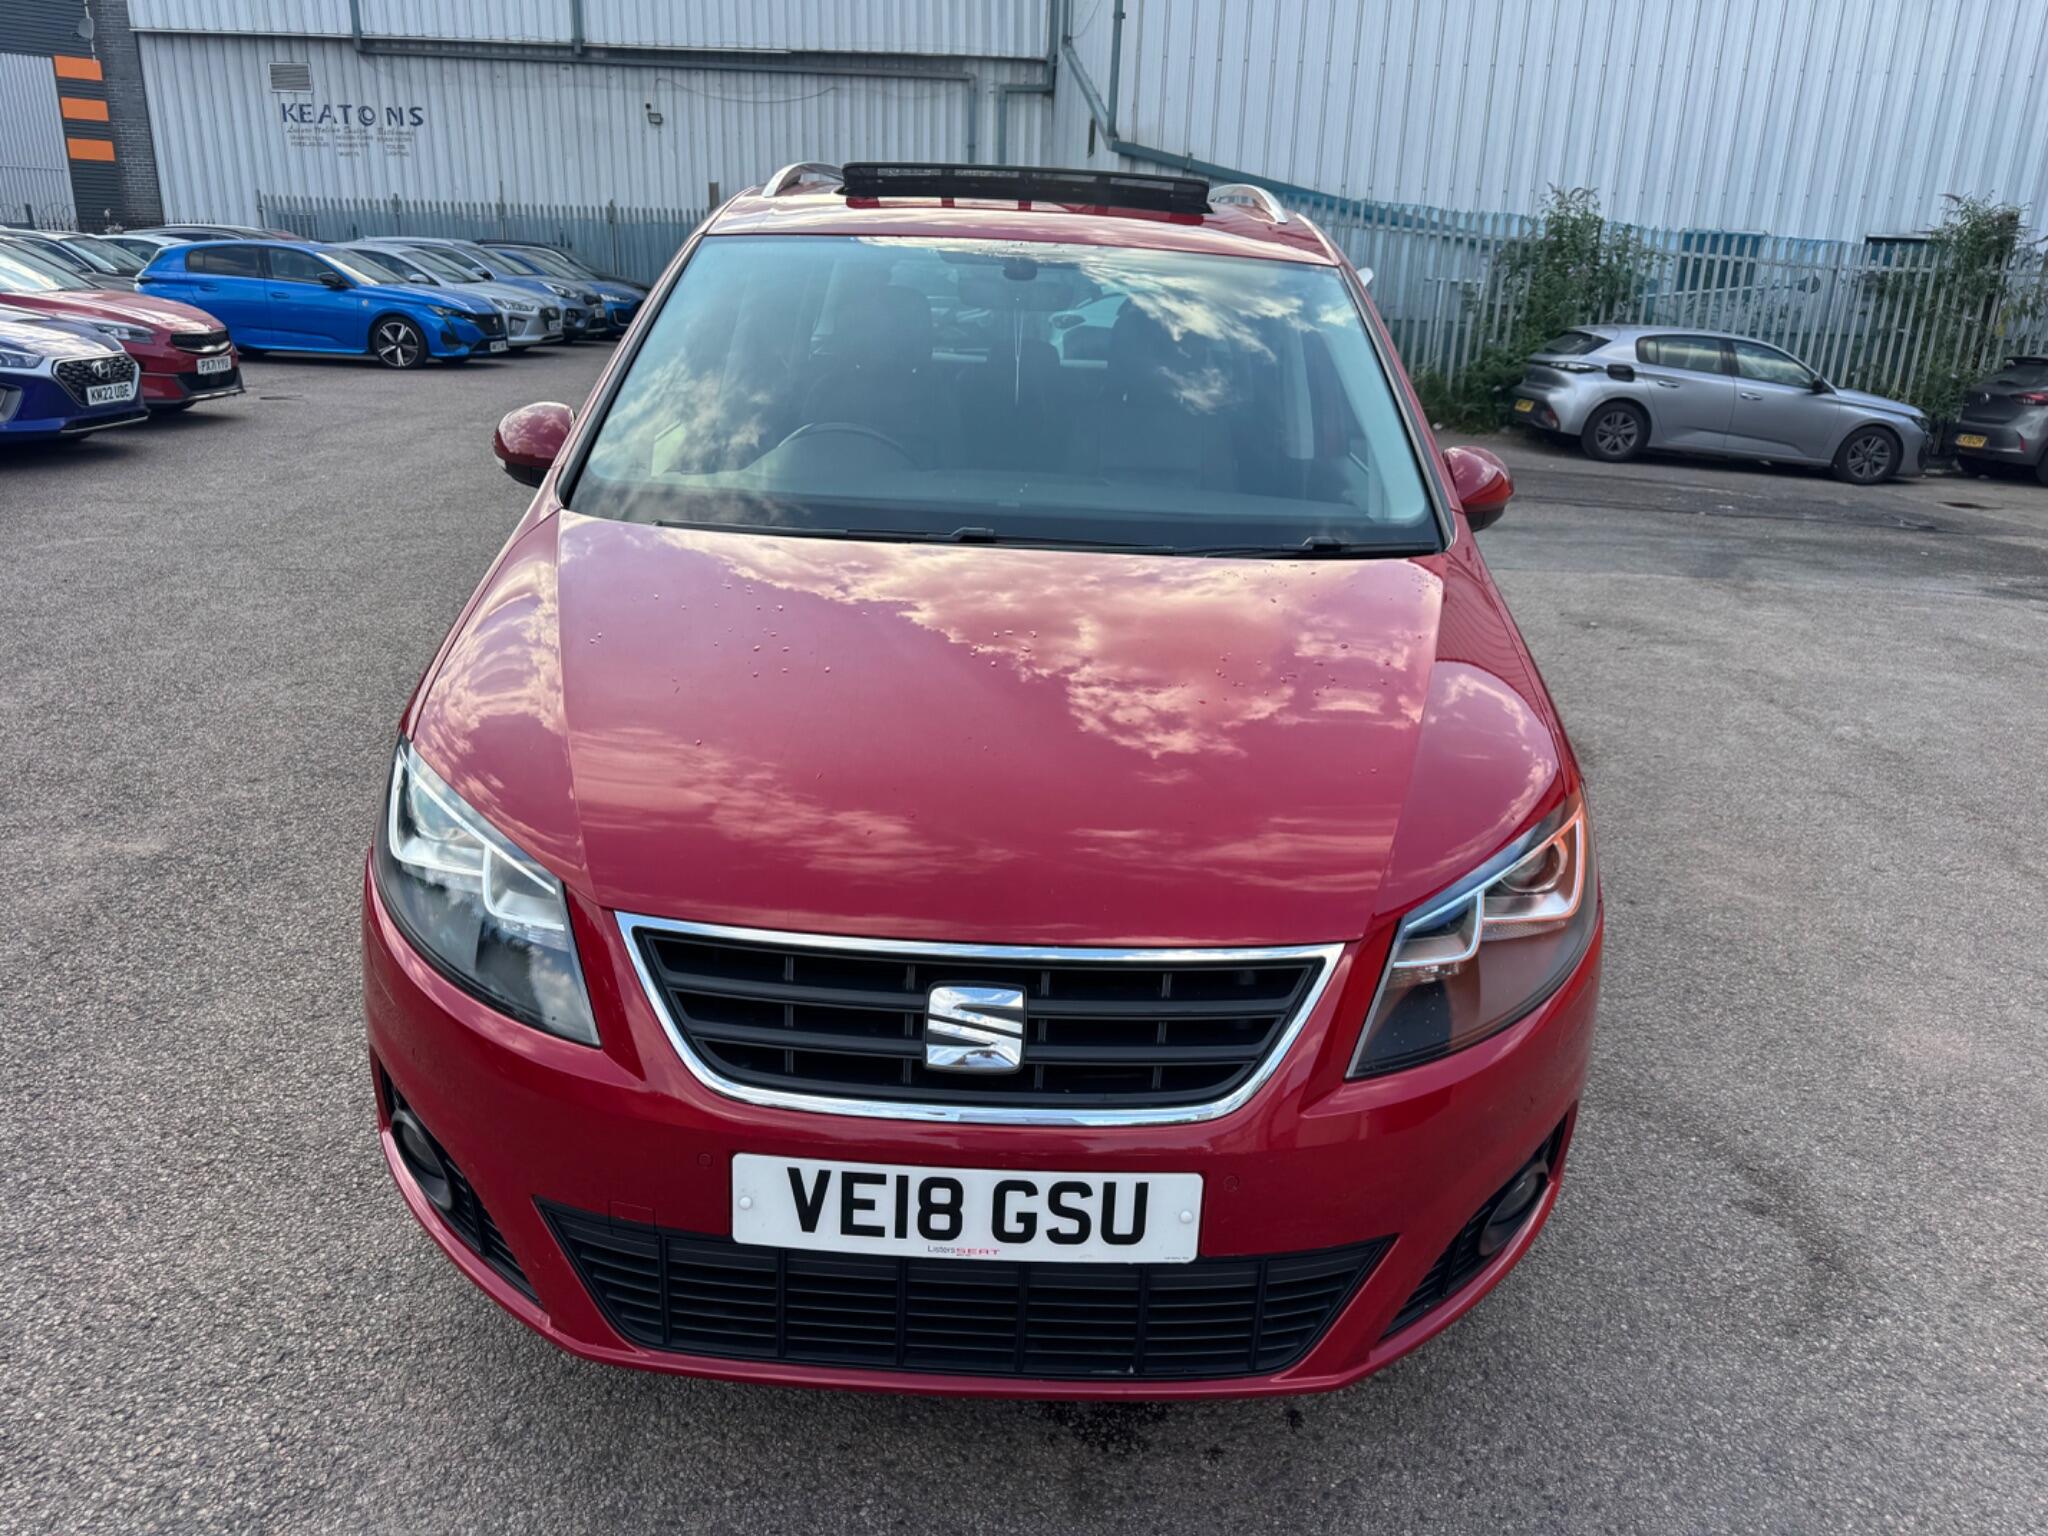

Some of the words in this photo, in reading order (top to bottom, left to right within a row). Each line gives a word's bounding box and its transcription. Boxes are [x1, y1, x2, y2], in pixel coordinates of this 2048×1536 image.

[281, 102, 424, 127] KEATONS
[786, 1166, 964, 1241] VE18
[991, 1179, 1149, 1246] GSU
